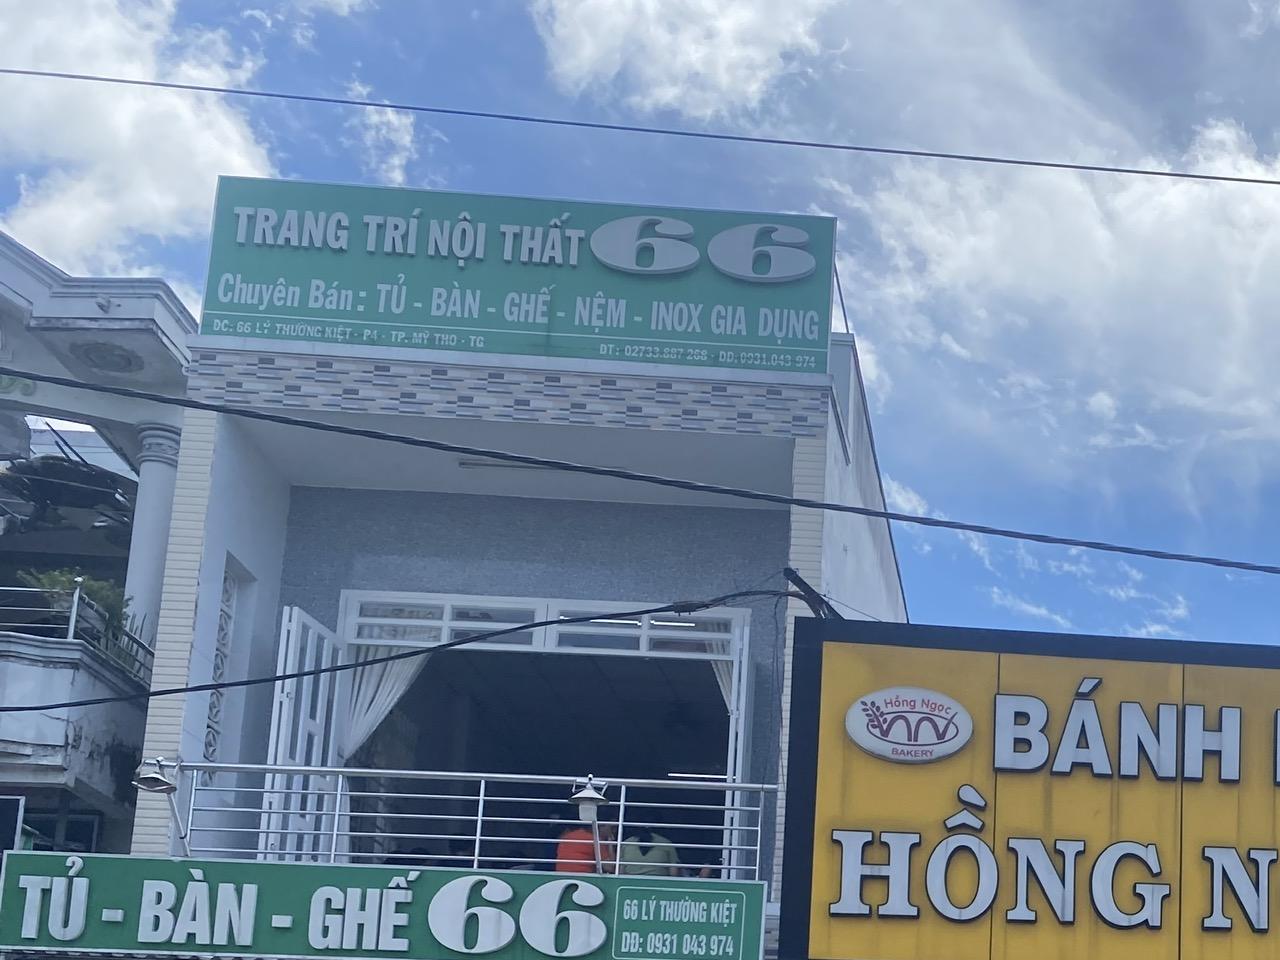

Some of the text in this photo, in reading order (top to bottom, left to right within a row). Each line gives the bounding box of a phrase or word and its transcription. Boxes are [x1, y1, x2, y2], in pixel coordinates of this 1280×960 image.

[234, 207, 816, 283] TRANG TRÍ NỘI THẤT 66
[217, 272, 300, 310] Chuyên
[377, 273, 406, 313] TỦ
[431, 281, 480, 318] BÀN
[504, 284, 556, 323] GHẾ
[575, 291, 626, 334] NỆM
[651, 301, 703, 333] INOX
[711, 305, 747, 336] GIA
[758, 308, 819, 344] DỤNG
[236, 321, 251, 334] 66
[469, 335, 485, 348] TG
[891, 747, 934, 758] BAKERY
[993, 678, 1242, 784] BÁNH
[829, 783, 1170, 930] HỒNG
[18, 856, 608, 957] TỦ BÀN GHẾ 66
[623, 899, 639, 920] 66
[642, 896, 656, 921] LÝ
[710, 899, 737, 927] KIỆT
[646, 932, 677, 954] 0931
[682, 934, 706, 956] 043
[710, 935, 734, 956] 974
